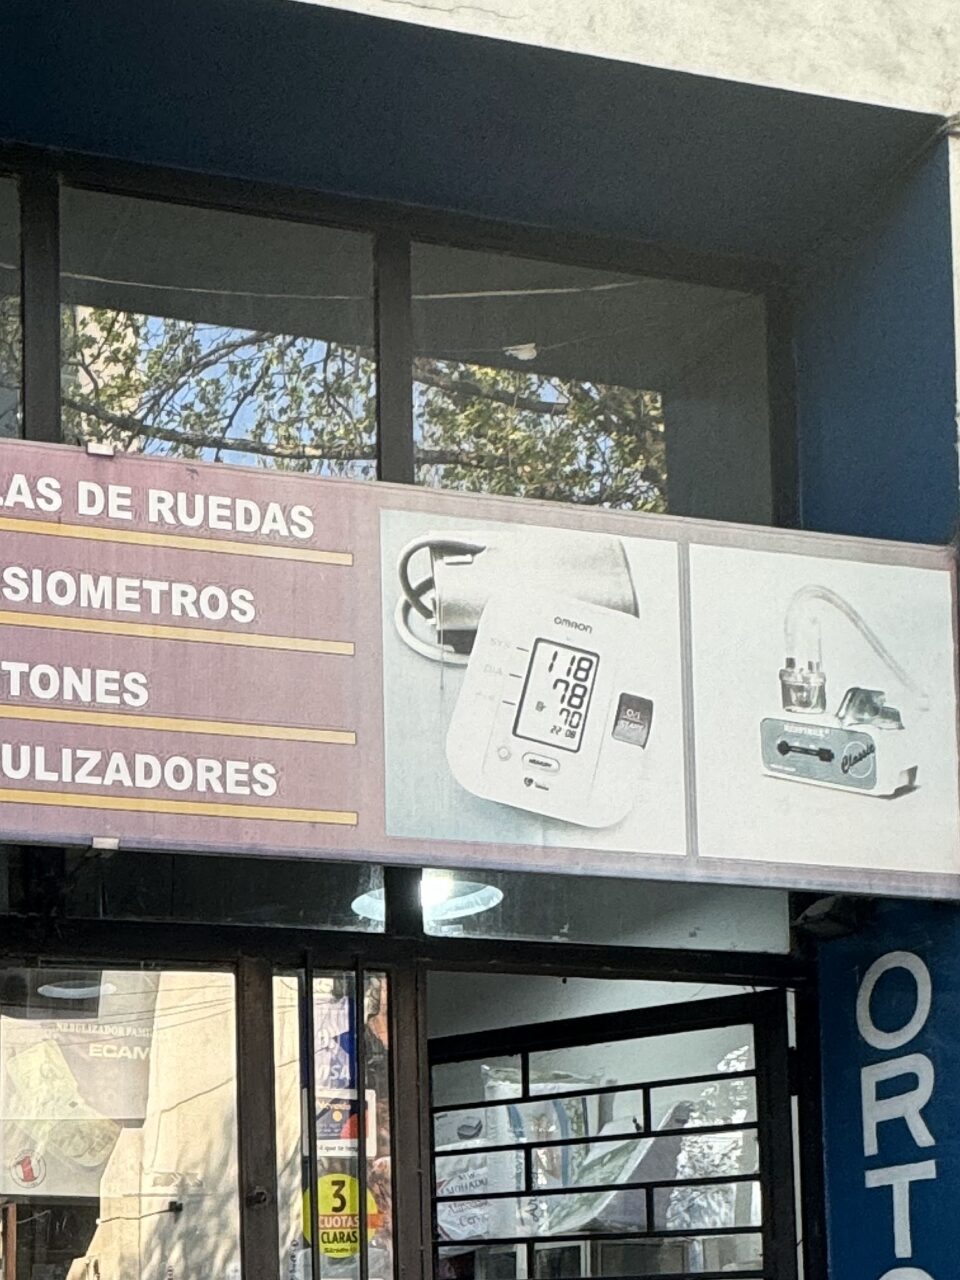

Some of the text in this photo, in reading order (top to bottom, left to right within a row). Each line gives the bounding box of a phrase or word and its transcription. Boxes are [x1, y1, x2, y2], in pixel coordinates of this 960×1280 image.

[78, 481, 133, 520] DE
[148, 489, 315, 539] RUEDAS
[548, 650, 594, 683] 118
[553, 678, 588, 709] 78
[559, 707, 582, 729] 70
[331, 1180, 347, 1213] 3
[319, 1215, 359, 1229] CUOTAS
[321, 1231, 358, 1245] CLARAS
